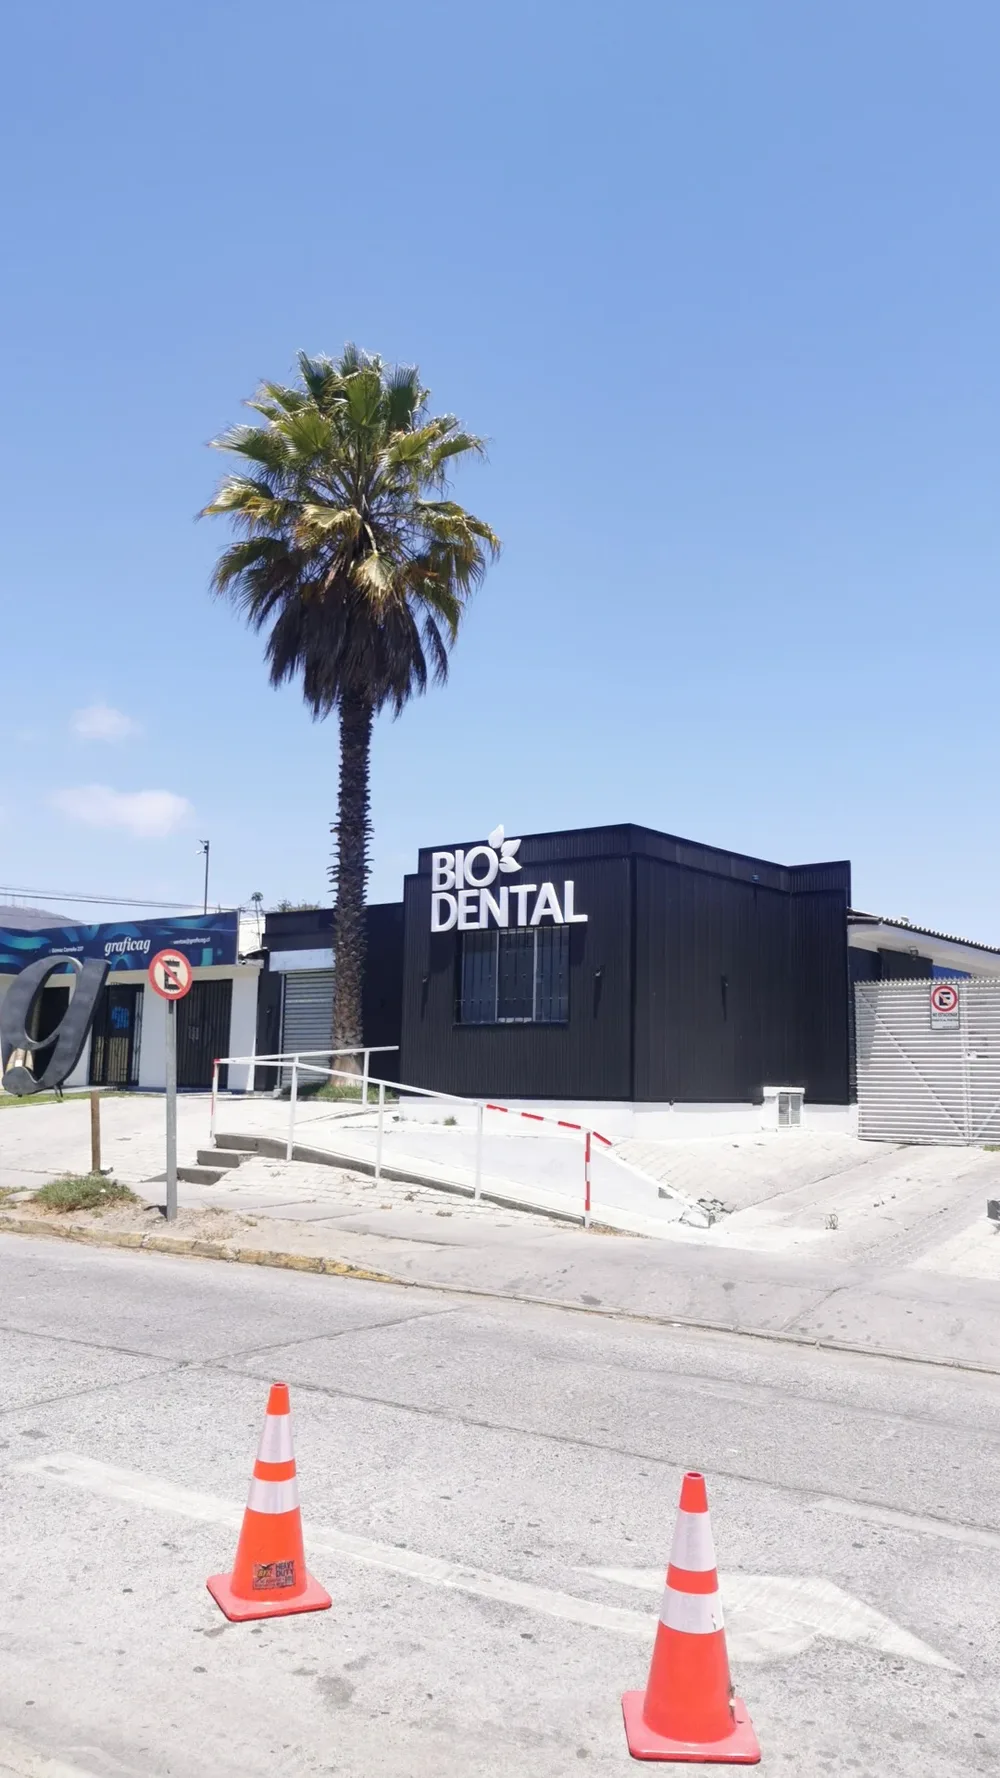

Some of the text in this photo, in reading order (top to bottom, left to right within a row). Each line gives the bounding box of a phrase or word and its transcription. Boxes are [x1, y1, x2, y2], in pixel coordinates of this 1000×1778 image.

[432, 845, 499, 892] BIO
[431, 880, 588, 932] DENTAL
[104, 936, 151, 957] graficag
